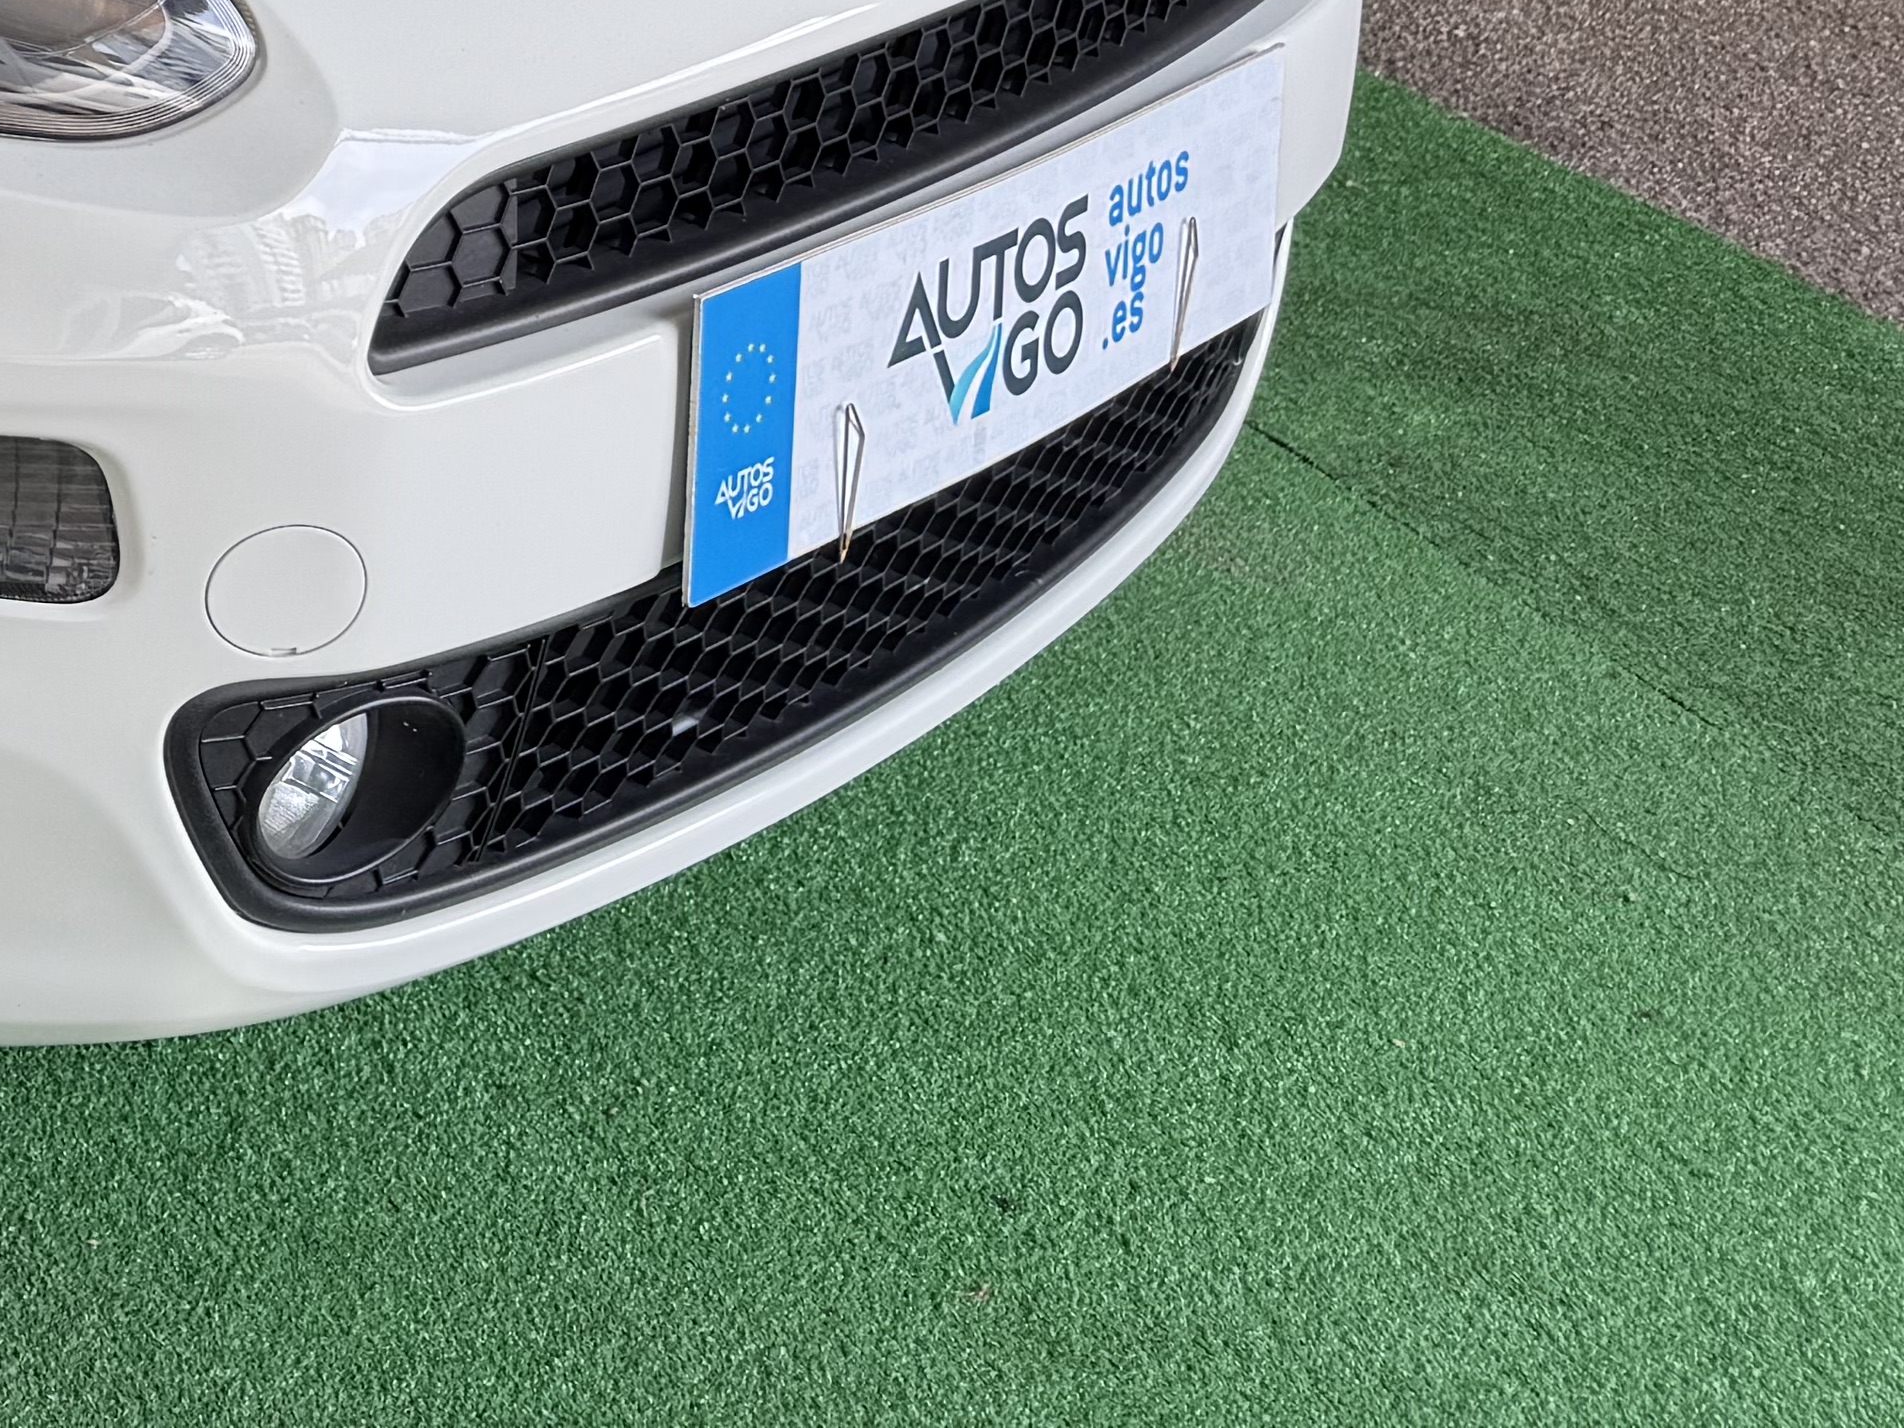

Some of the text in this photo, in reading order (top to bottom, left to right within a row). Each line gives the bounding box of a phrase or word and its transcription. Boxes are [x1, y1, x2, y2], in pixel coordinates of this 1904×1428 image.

[1107, 149, 1191, 228] autos
[887, 192, 1090, 369] AUTOS
[1104, 220, 1165, 293] vigo
[928, 289, 1085, 425] VIGO
[1100, 290, 1146, 351] .es
[713, 455, 776, 508] AUTOS
